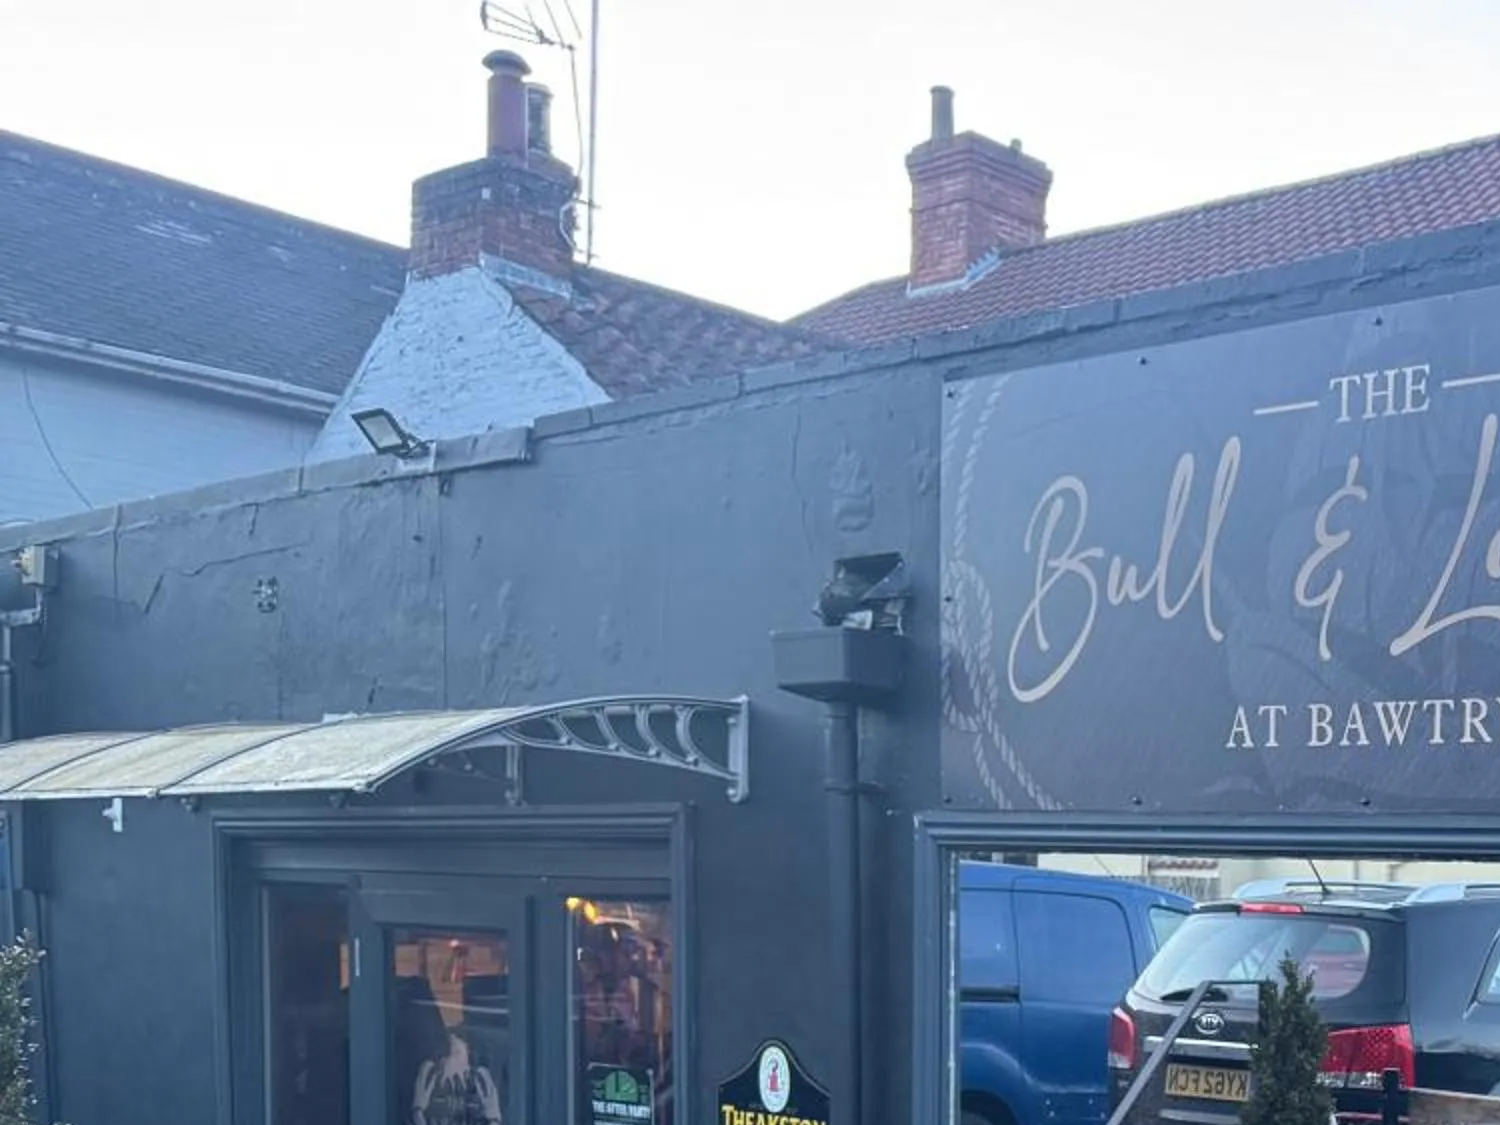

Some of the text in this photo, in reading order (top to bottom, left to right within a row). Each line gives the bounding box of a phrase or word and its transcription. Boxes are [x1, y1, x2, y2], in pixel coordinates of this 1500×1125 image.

[1329, 364, 1431, 424] THE
[1007, 436, 1241, 703] Bull
[1294, 454, 1368, 661] &
[1225, 703, 1287, 749] AT
